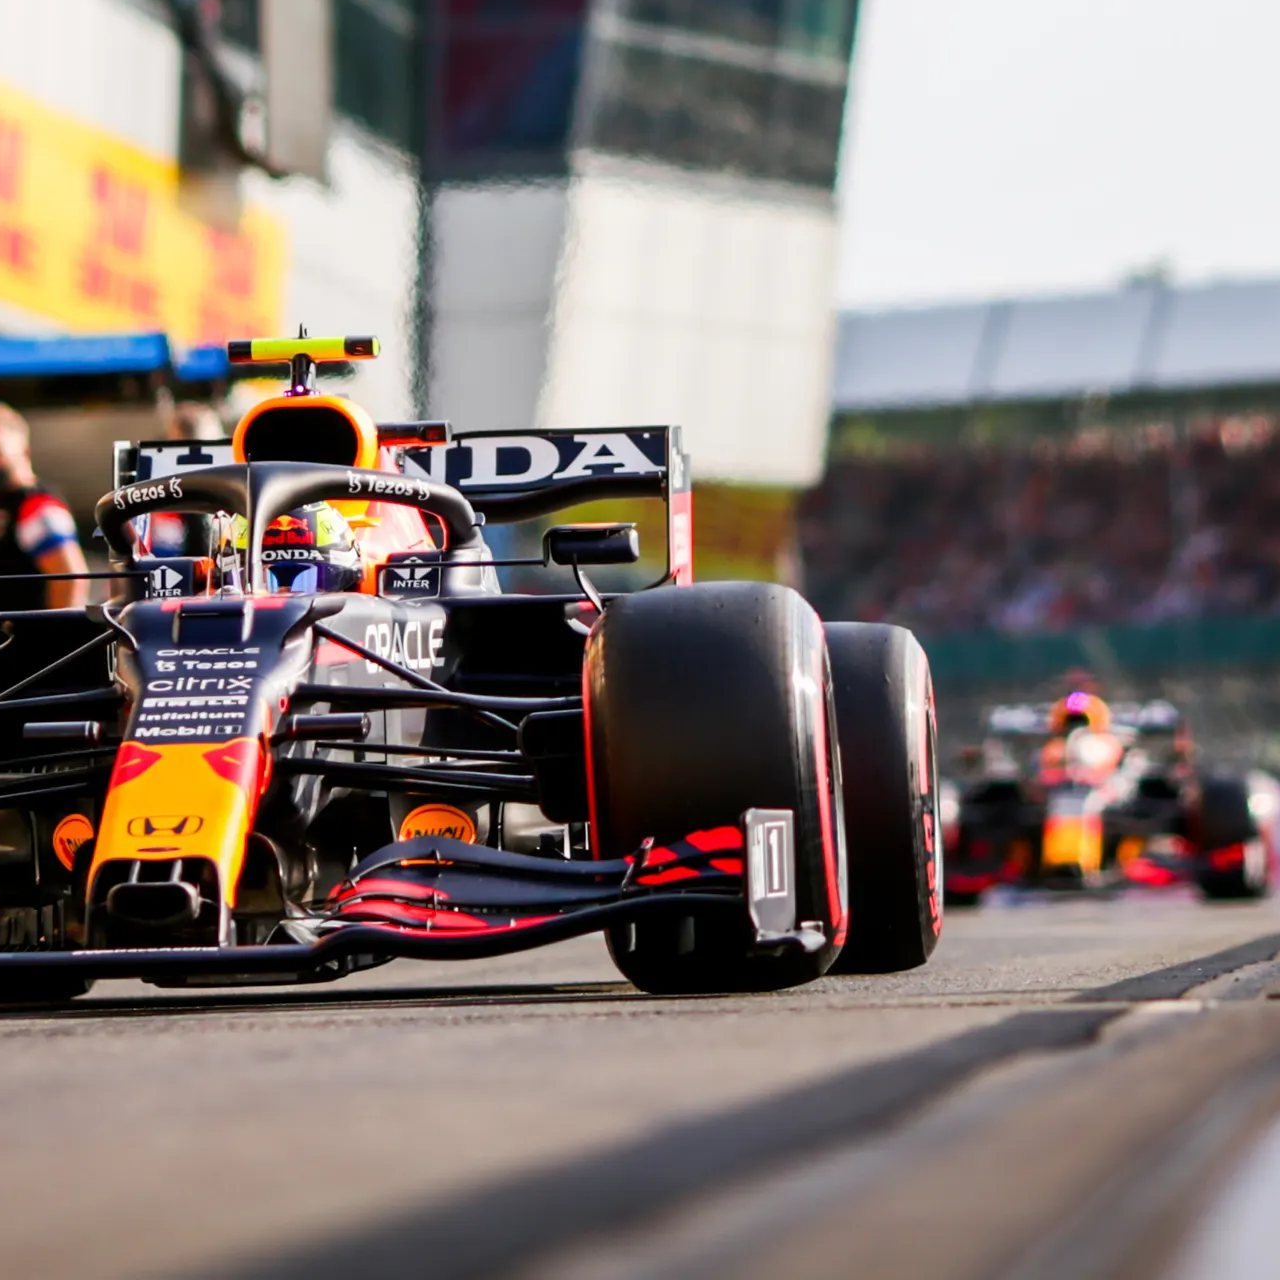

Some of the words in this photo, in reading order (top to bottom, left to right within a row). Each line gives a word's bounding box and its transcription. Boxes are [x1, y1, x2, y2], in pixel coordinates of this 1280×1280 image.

[366, 475, 414, 497] Tezos
[126, 483, 166, 504] Tezos
[287, 531, 315, 545] Bull
[261, 549, 325, 562] ONDA
[393, 579, 430, 589] INTER
[156, 647, 261, 657] ORACLE
[364, 620, 446, 674] ORACLE
[183, 660, 258, 670] Tezos
[138, 712, 246, 722] infinitum
[134, 725, 212, 738] Mobil
